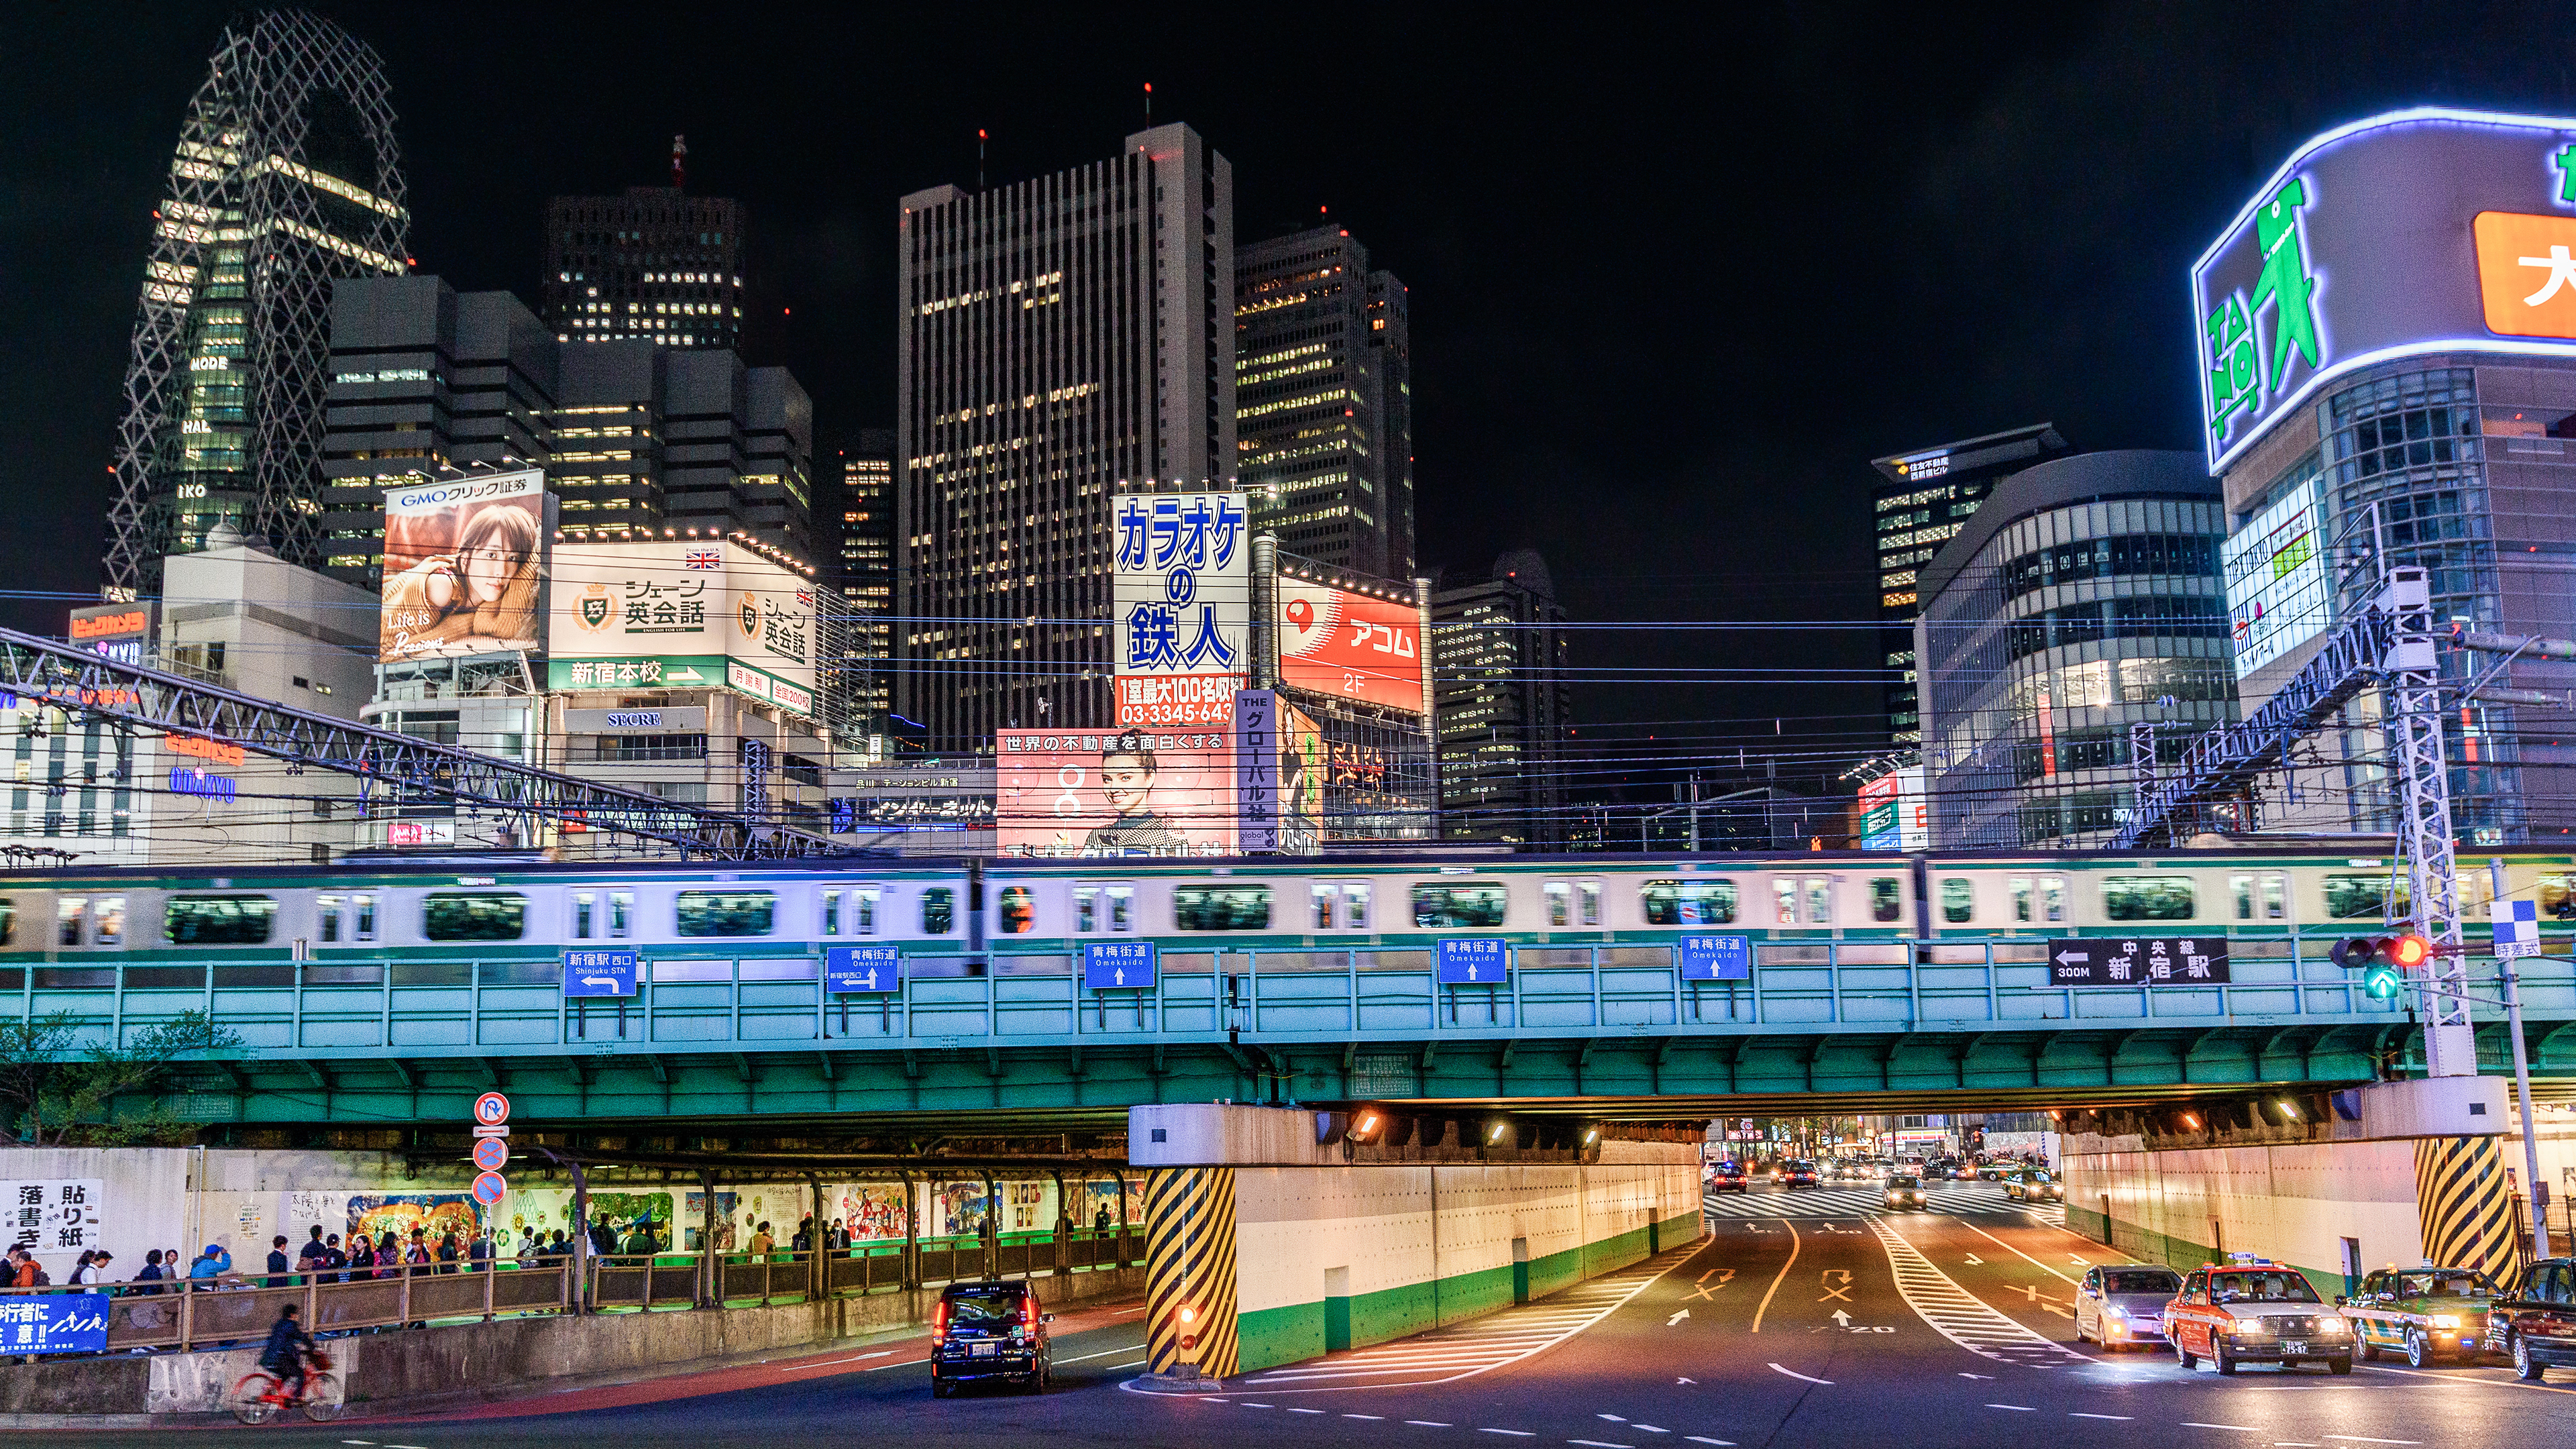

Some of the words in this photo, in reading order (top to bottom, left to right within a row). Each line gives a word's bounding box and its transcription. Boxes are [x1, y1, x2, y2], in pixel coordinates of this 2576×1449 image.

[190, 356, 228, 371] MODE
[182, 420, 211, 433] HAL
[401, 479, 527, 506] GMOクリック証券
[1116, 496, 1244, 572] カラオケ
[625, 580, 705, 598] シェーン
[1165, 564, 1197, 609] の
[387, 612, 415, 629] Life
[418, 612, 430, 625] is
[625, 601, 704, 625] 英会話
[765, 598, 805, 629] シェーン
[765, 619, 805, 657] 英会話
[1126, 602, 1236, 670] 鉄人
[1350, 618, 1415, 658] アコム
[572, 661, 662, 684] 新宿本校
[735, 669, 762, 691] 月謝制
[1344, 673, 1365, 694] 2F
[775, 685, 810, 709] 全国200校
[1243, 698, 1267, 707] THE
[608, 712, 661, 725] SECRE
[1006, 735, 1223, 752] 世界の不動産を面白くする
[1247, 712, 1267, 822] グローバル社
[1240, 832, 1264, 843] global
[1092, 945, 1146, 957] 青梅街道
[1446, 941, 1499, 953] 青梅街道
[1688, 938, 1740, 951] 青梅街道
[2122, 940, 2196, 955] 中央線
[2496, 942, 2538, 957] 時差式
[570, 953, 609, 966] 新宿駅
[612, 955, 632, 965] 西口
[851, 948, 896, 960] 青梅街道
[1449, 954, 1495, 962] Omekaido
[575, 967, 608, 976] Shinjuku
[611, 967, 626, 975] STN
[2057, 967, 2090, 977] 300M
[2108, 955, 2212, 980] 新宿駅
[17, 1185, 44, 1248] 落書き
[59, 1185, 85, 1247] 貼り紙
[0, 1303, 49, 1323] 行者に
